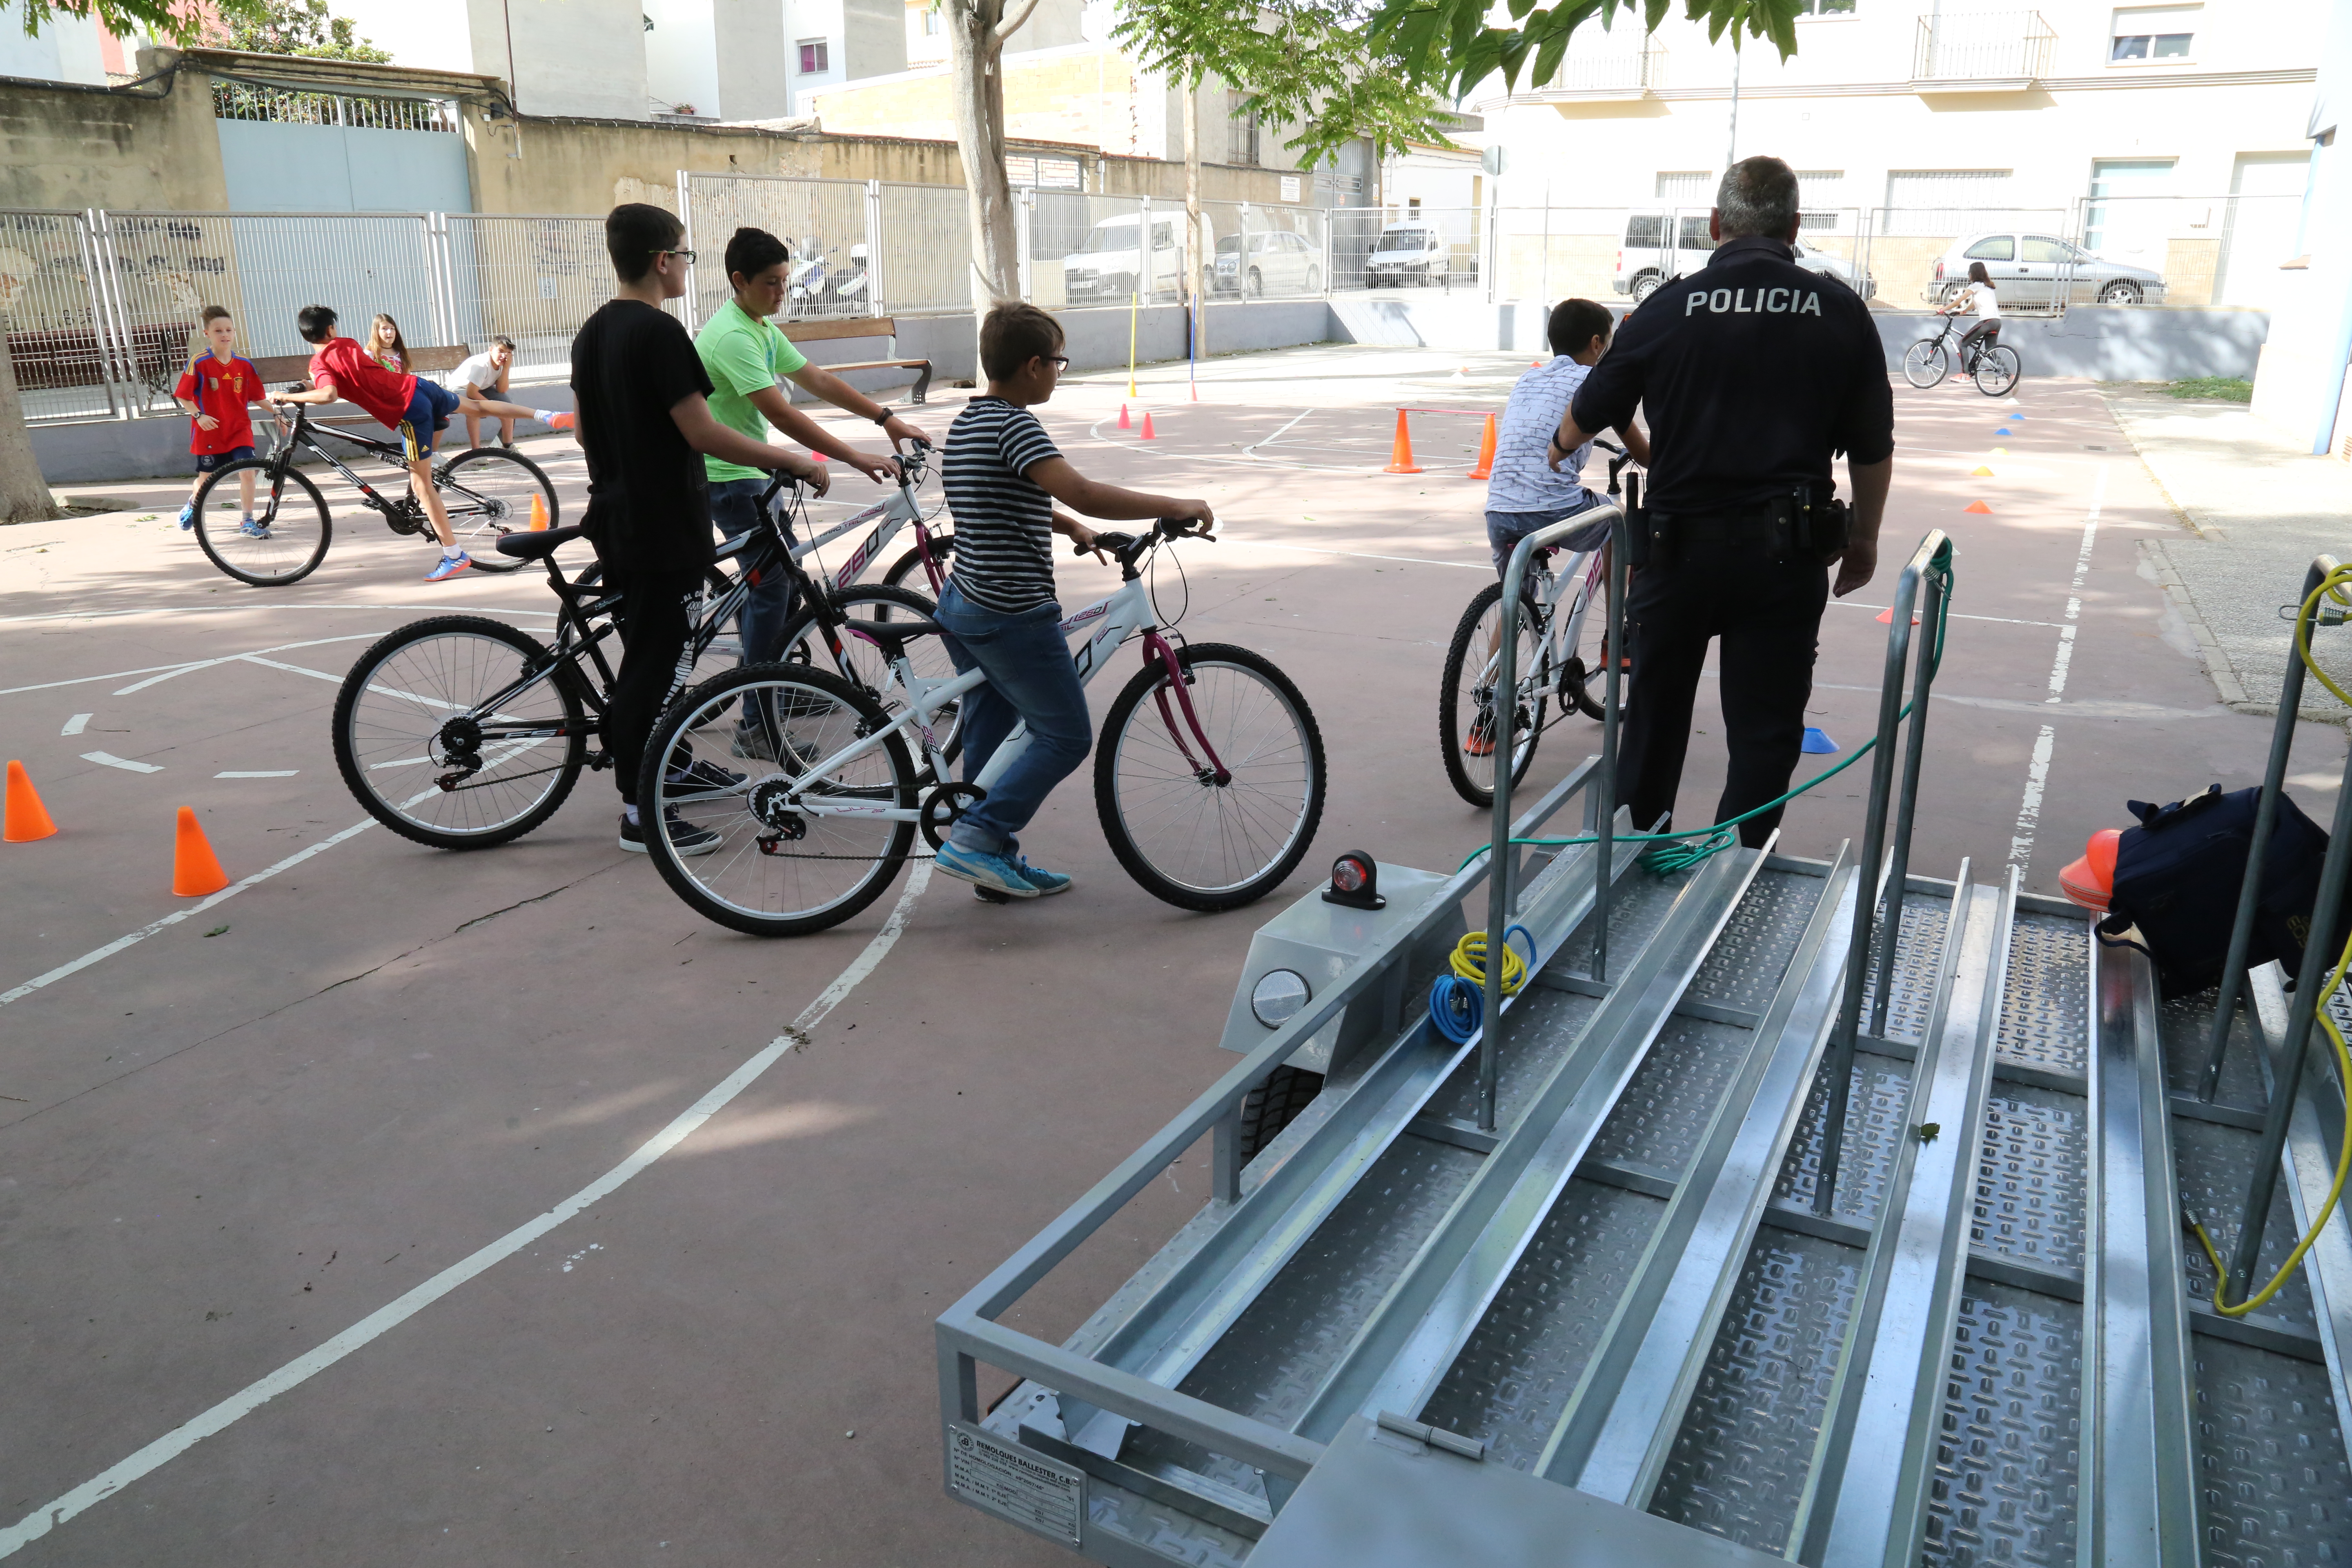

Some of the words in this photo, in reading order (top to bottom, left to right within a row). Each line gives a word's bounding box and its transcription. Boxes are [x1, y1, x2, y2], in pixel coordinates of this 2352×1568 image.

[1686, 288, 1821, 316] POLICIA
[844, 519, 862, 528] TAIL
[1586, 550, 1601, 602] 26
[1096, 626, 1108, 642] SPORT
[977, 1440, 1016, 1463] REMOLQUES
[1018, 1458, 1057, 1481] BALLESTER,
[1059, 1474, 1071, 1486] C.B.
[997, 1491, 1007, 1499] EJE
[997, 1499, 1007, 1507] EJE
